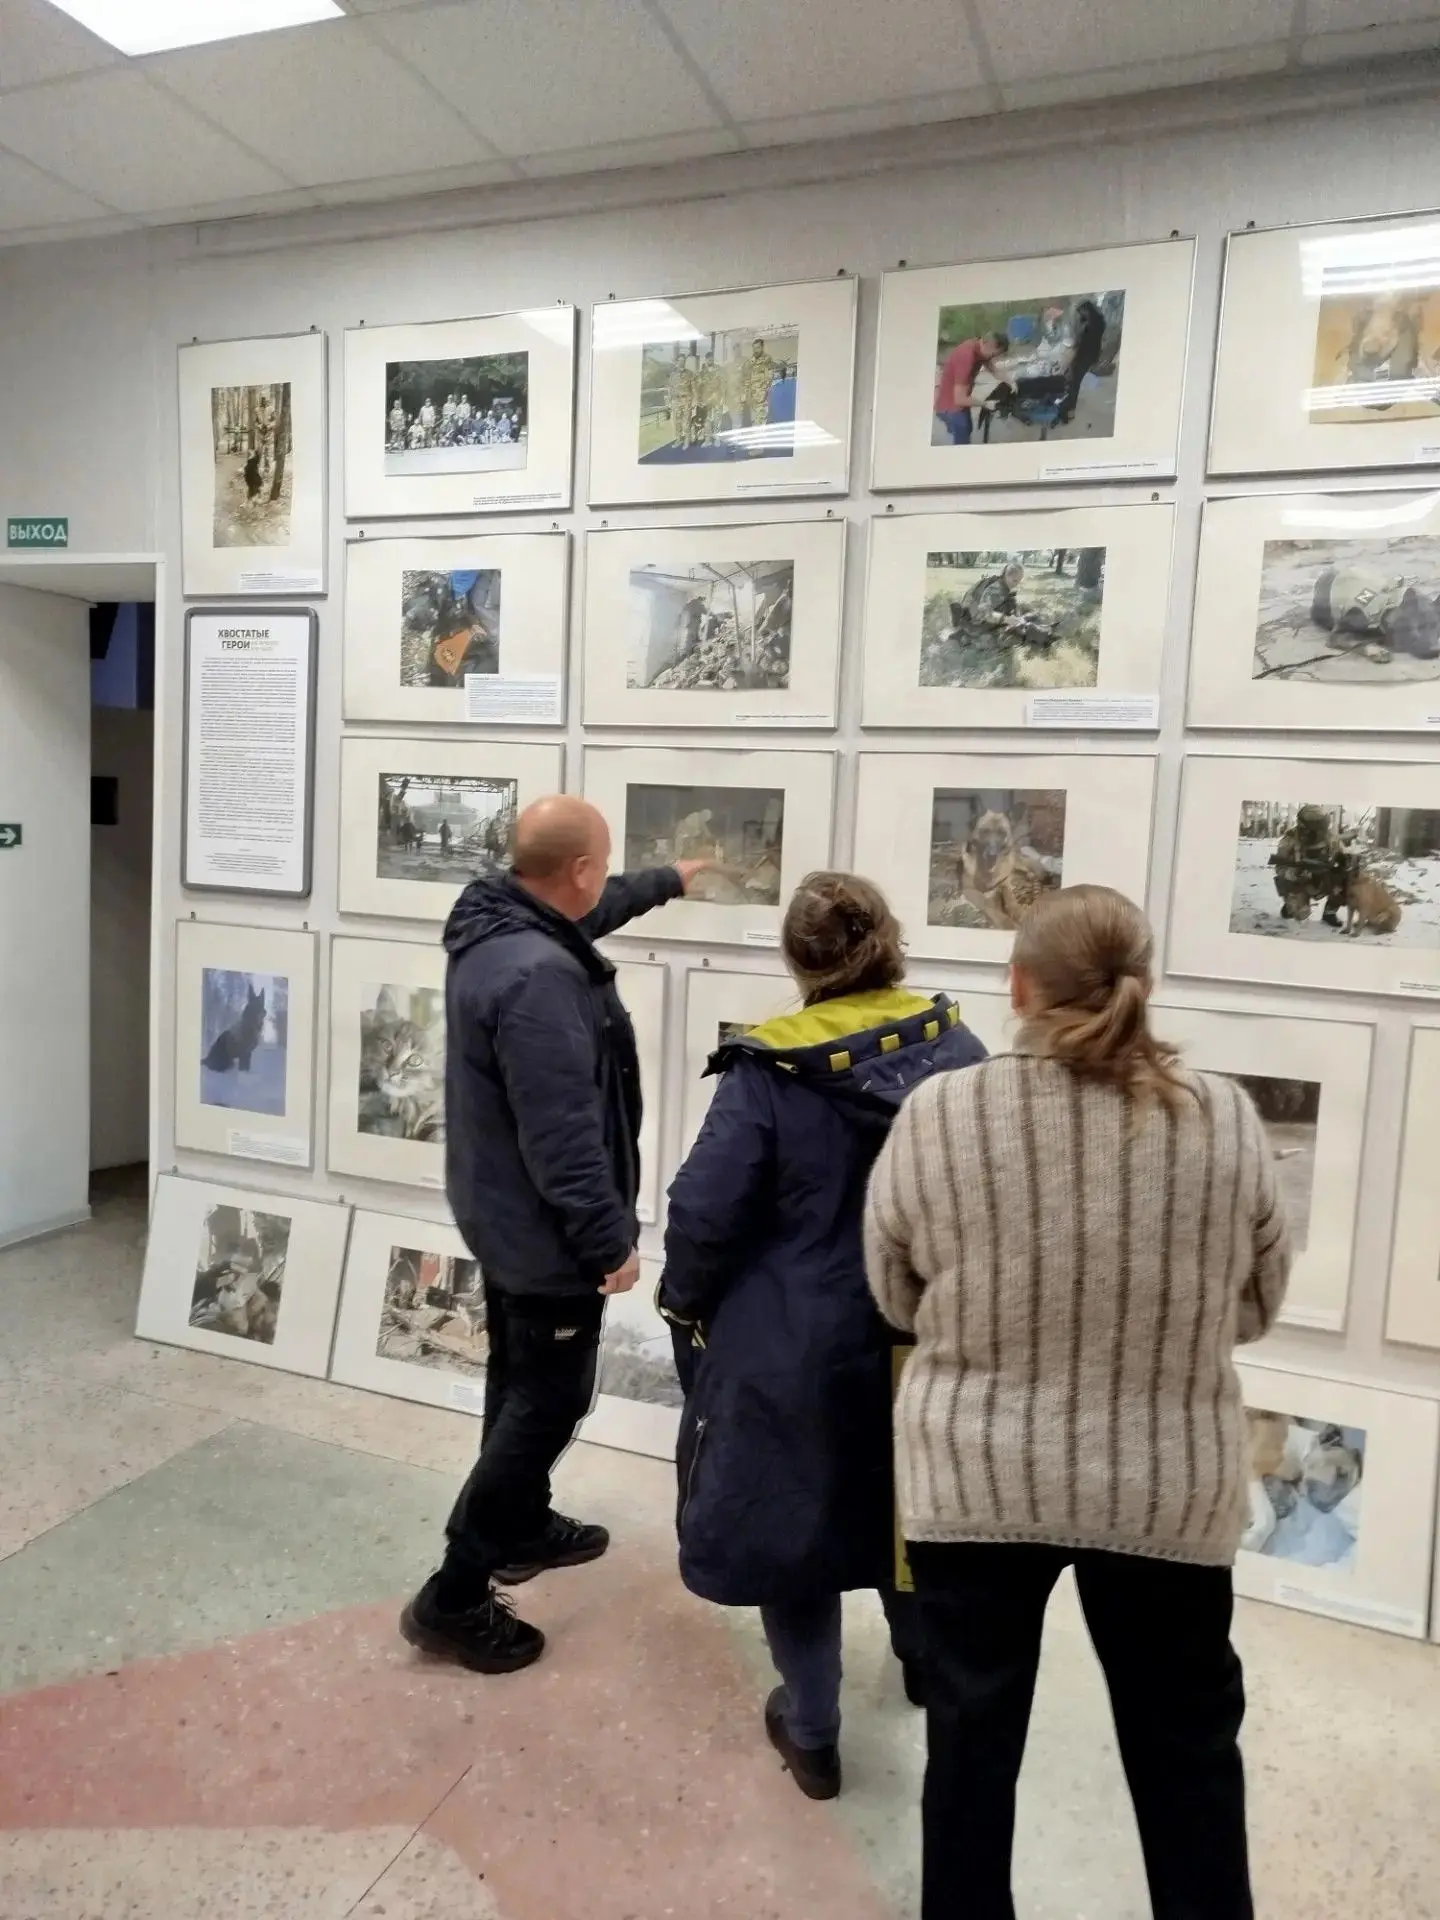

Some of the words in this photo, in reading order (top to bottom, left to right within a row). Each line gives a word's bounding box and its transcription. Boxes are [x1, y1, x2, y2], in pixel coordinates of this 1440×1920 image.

[9, 524, 67, 542] ВЫХОД
[217, 629, 270, 638] ХВОСТАТЫЕ
[221, 640, 251, 649] ГЕРОИ
